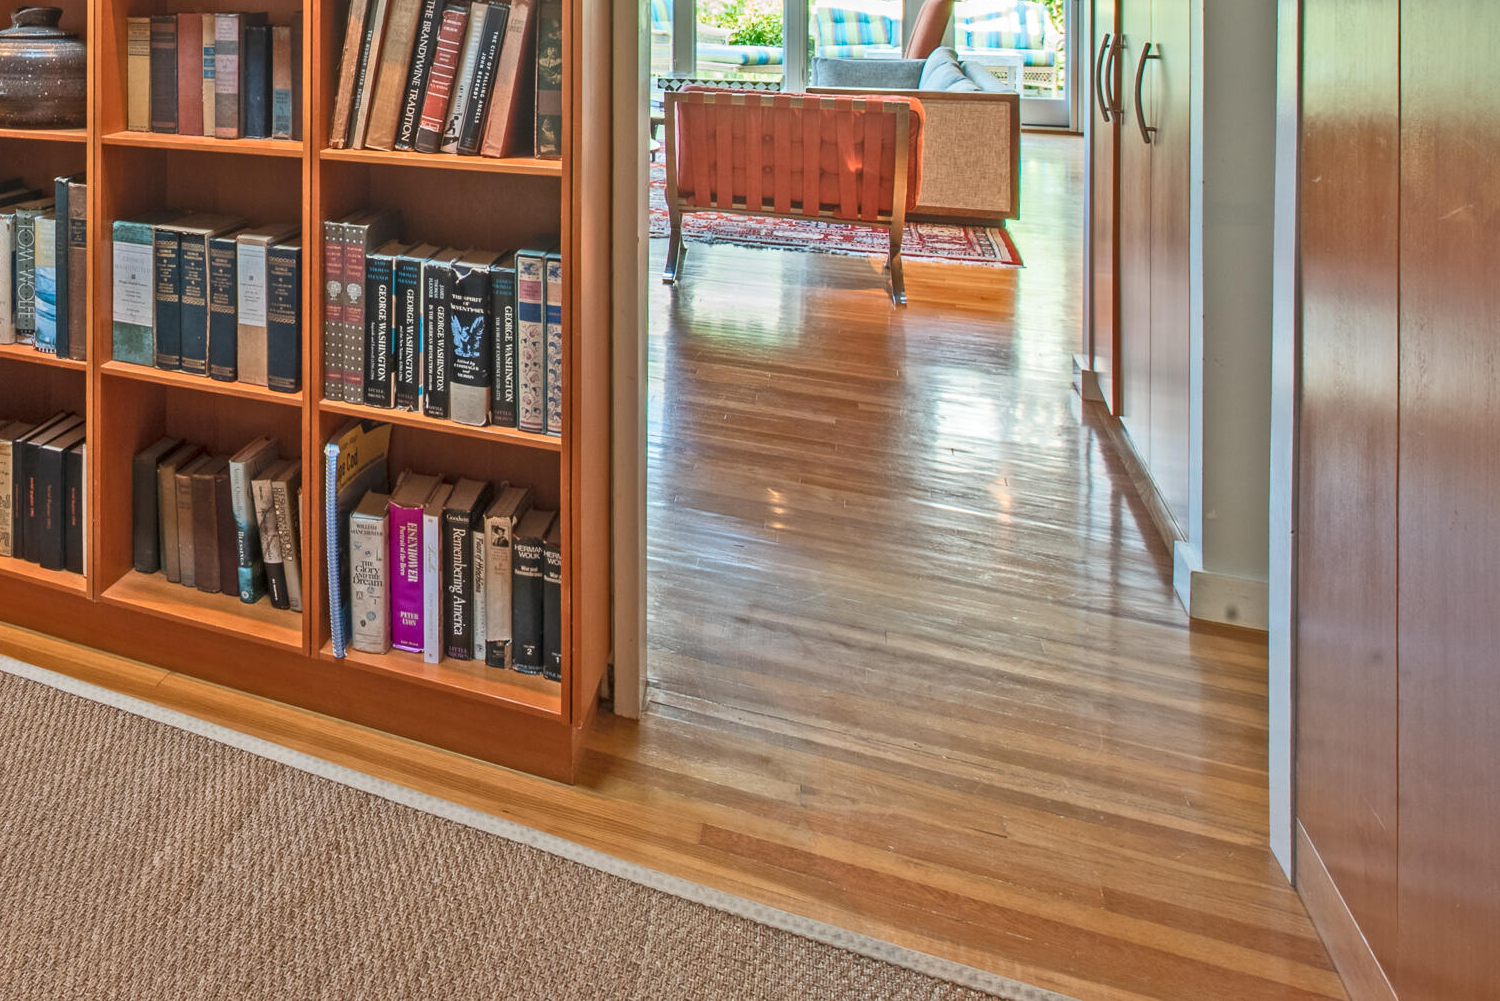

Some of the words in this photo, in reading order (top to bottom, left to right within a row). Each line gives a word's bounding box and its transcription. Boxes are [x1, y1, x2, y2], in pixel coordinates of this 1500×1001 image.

[424, 0, 436, 18] THE
[491, 31, 499, 43] THE
[411, 21, 431, 87] BRANDYWINE
[479, 52, 487, 69] JOHN
[486, 62, 492, 70] OF
[488, 45, 496, 59] CITY
[472, 71, 483, 100] BERENDT
[479, 72, 490, 98] FALLING
[400, 89, 419, 142] TRADITION
[474, 100, 484, 124] ANGELS
[17, 222, 35, 261] TOM
[17, 269, 35, 319] WOLFE
[378, 285, 386, 321] GEORGE
[406, 289, 414, 324] GEORGE
[437, 306, 445, 338] GEORGE
[504, 306, 512, 341] GEORGE
[377, 323, 386, 381] WASHINGTON
[405, 326, 414, 384] WASHINGTON
[436, 339, 444, 391] WASHINGTON
[356, 523, 378, 531] WILLIAM
[237, 531, 245, 566] BLESSINGS
[406, 522, 419, 583] EISENHOWER
[449, 528, 465, 593] Remembering
[514, 544, 544, 553] HERMAN
[518, 551, 540, 560] WOUK
[352, 577, 383, 587] Dream
[355, 564, 380, 575] Glory
[400, 611, 419, 620] PETER
[402, 618, 417, 627] LYON
[453, 595, 466, 635] America
[527, 647, 533, 655] 2
